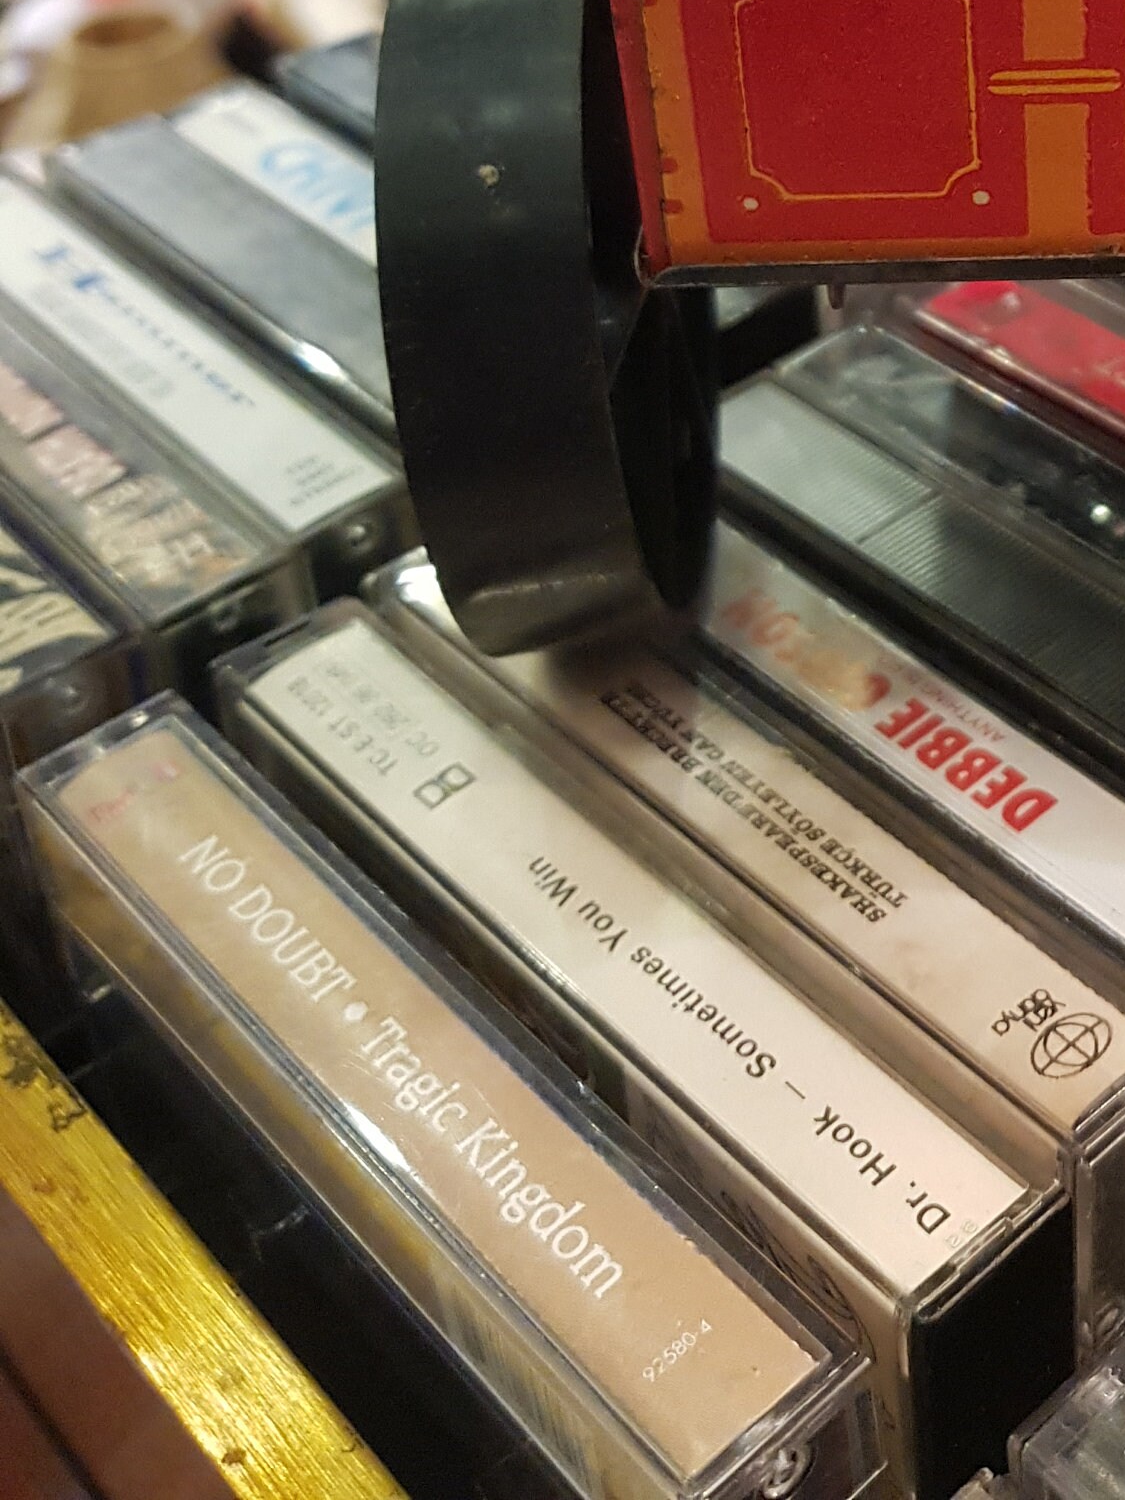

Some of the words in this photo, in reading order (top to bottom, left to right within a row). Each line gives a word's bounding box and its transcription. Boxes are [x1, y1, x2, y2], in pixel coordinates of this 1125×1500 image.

[873, 697, 1059, 834] DEBBIE
[528, 856, 579, 908] Win
[820, 838, 908, 909] TÜRKÇE
[578, 900, 629, 952] You
[630, 946, 777, 1079] Sometimes
[178, 834, 246, 894] NO
[227, 883, 357, 1004] DOUBT
[359, 1016, 469, 1133] Tragic
[454, 1114, 625, 1299] Kingdom
[793, 1104, 897, 1187] Hook
[905, 1180, 951, 1235] Dr.
